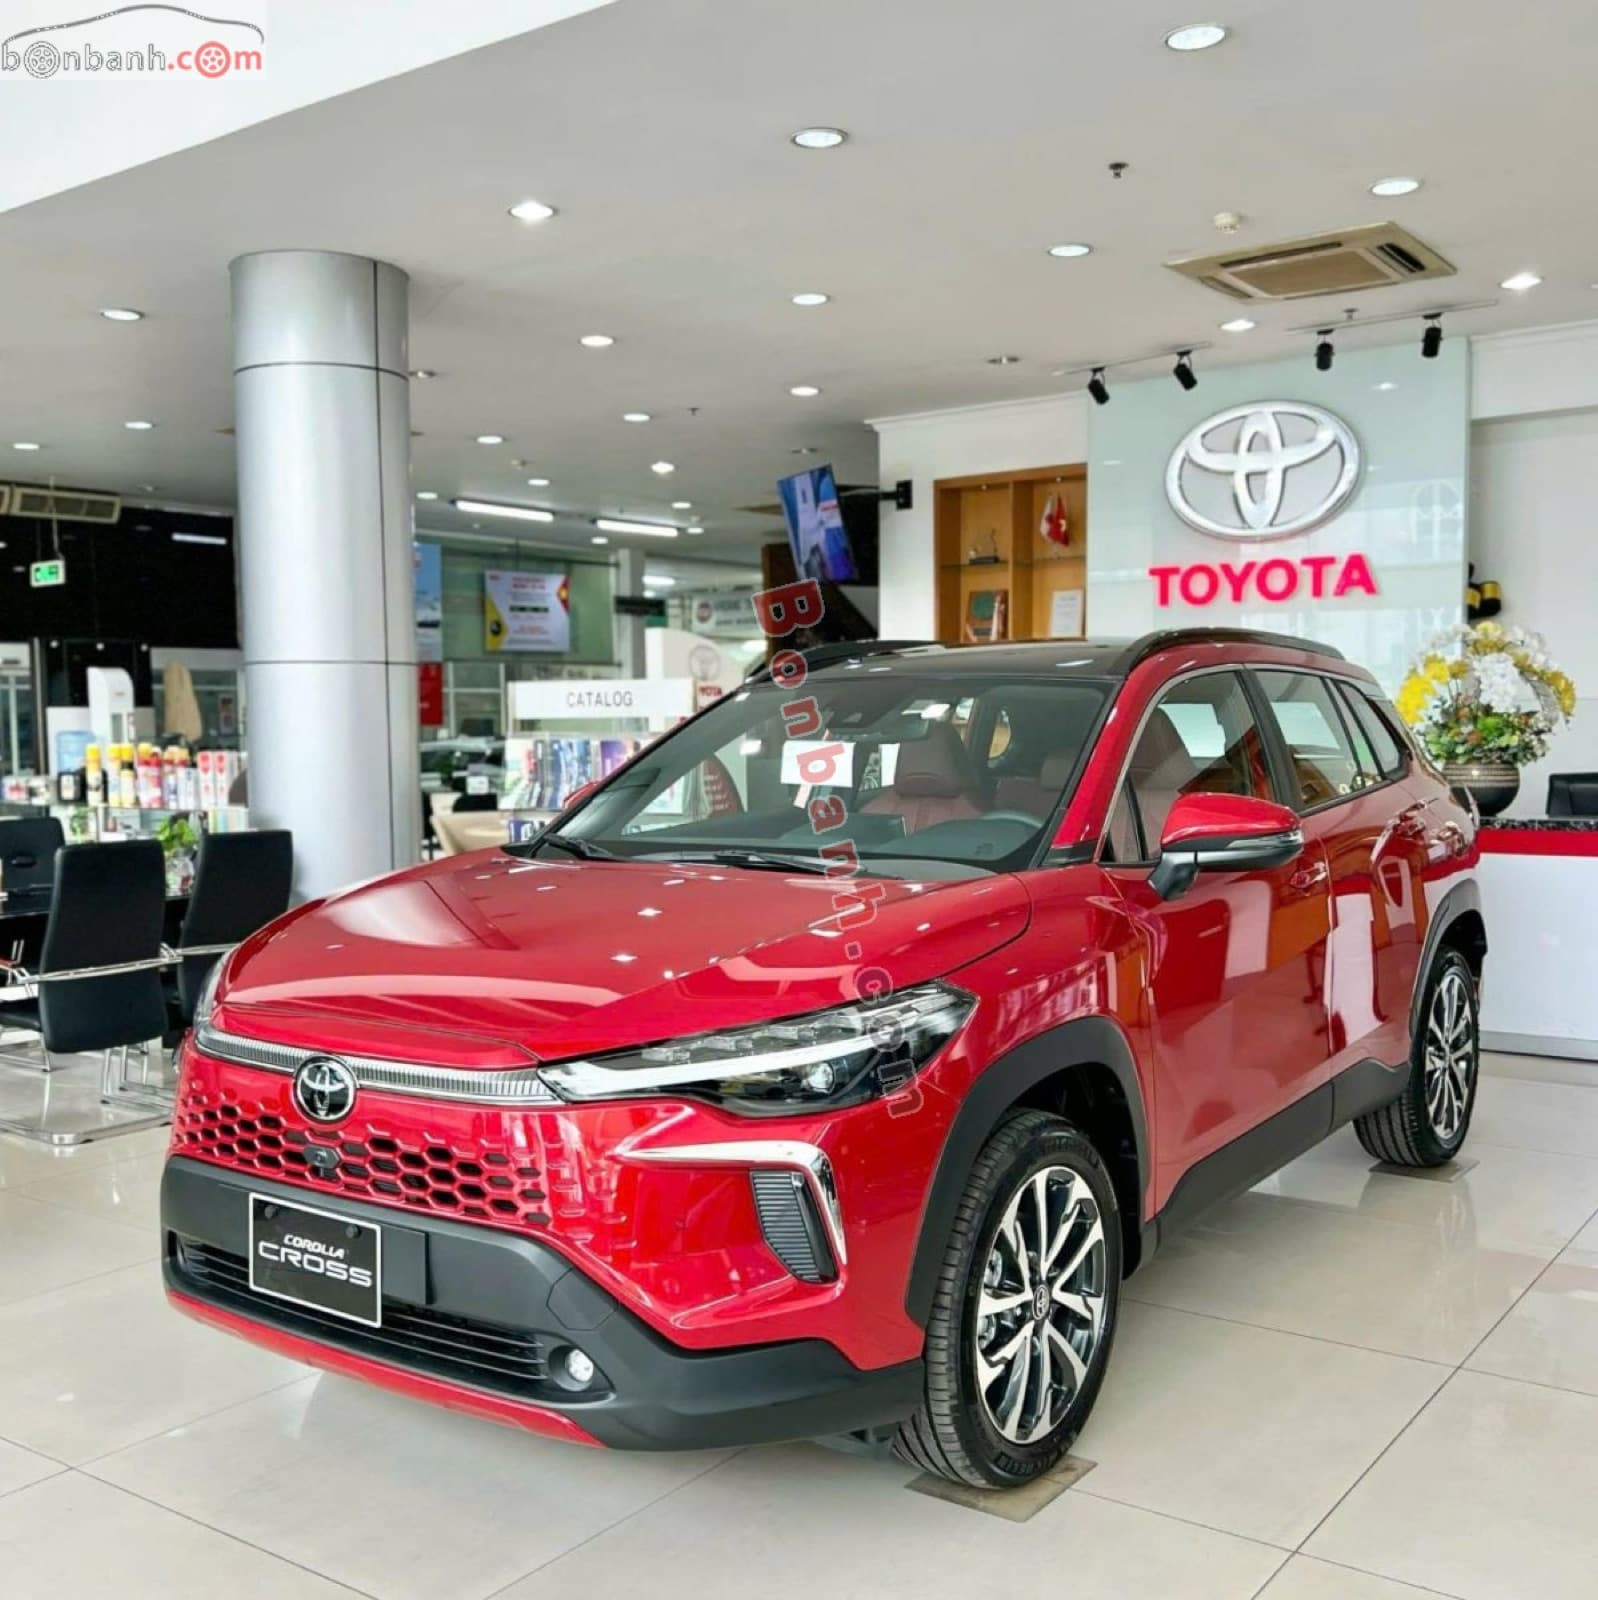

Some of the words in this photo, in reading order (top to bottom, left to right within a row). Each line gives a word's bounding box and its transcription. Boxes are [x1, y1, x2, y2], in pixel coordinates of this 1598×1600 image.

[1148, 553, 1378, 608] TOYOTA
[566, 690, 634, 709] CATALOG
[698, 685, 723, 697] YOTA
[284, 1235, 345, 1259] COROLLA
[258, 1241, 372, 1287] CROSS
